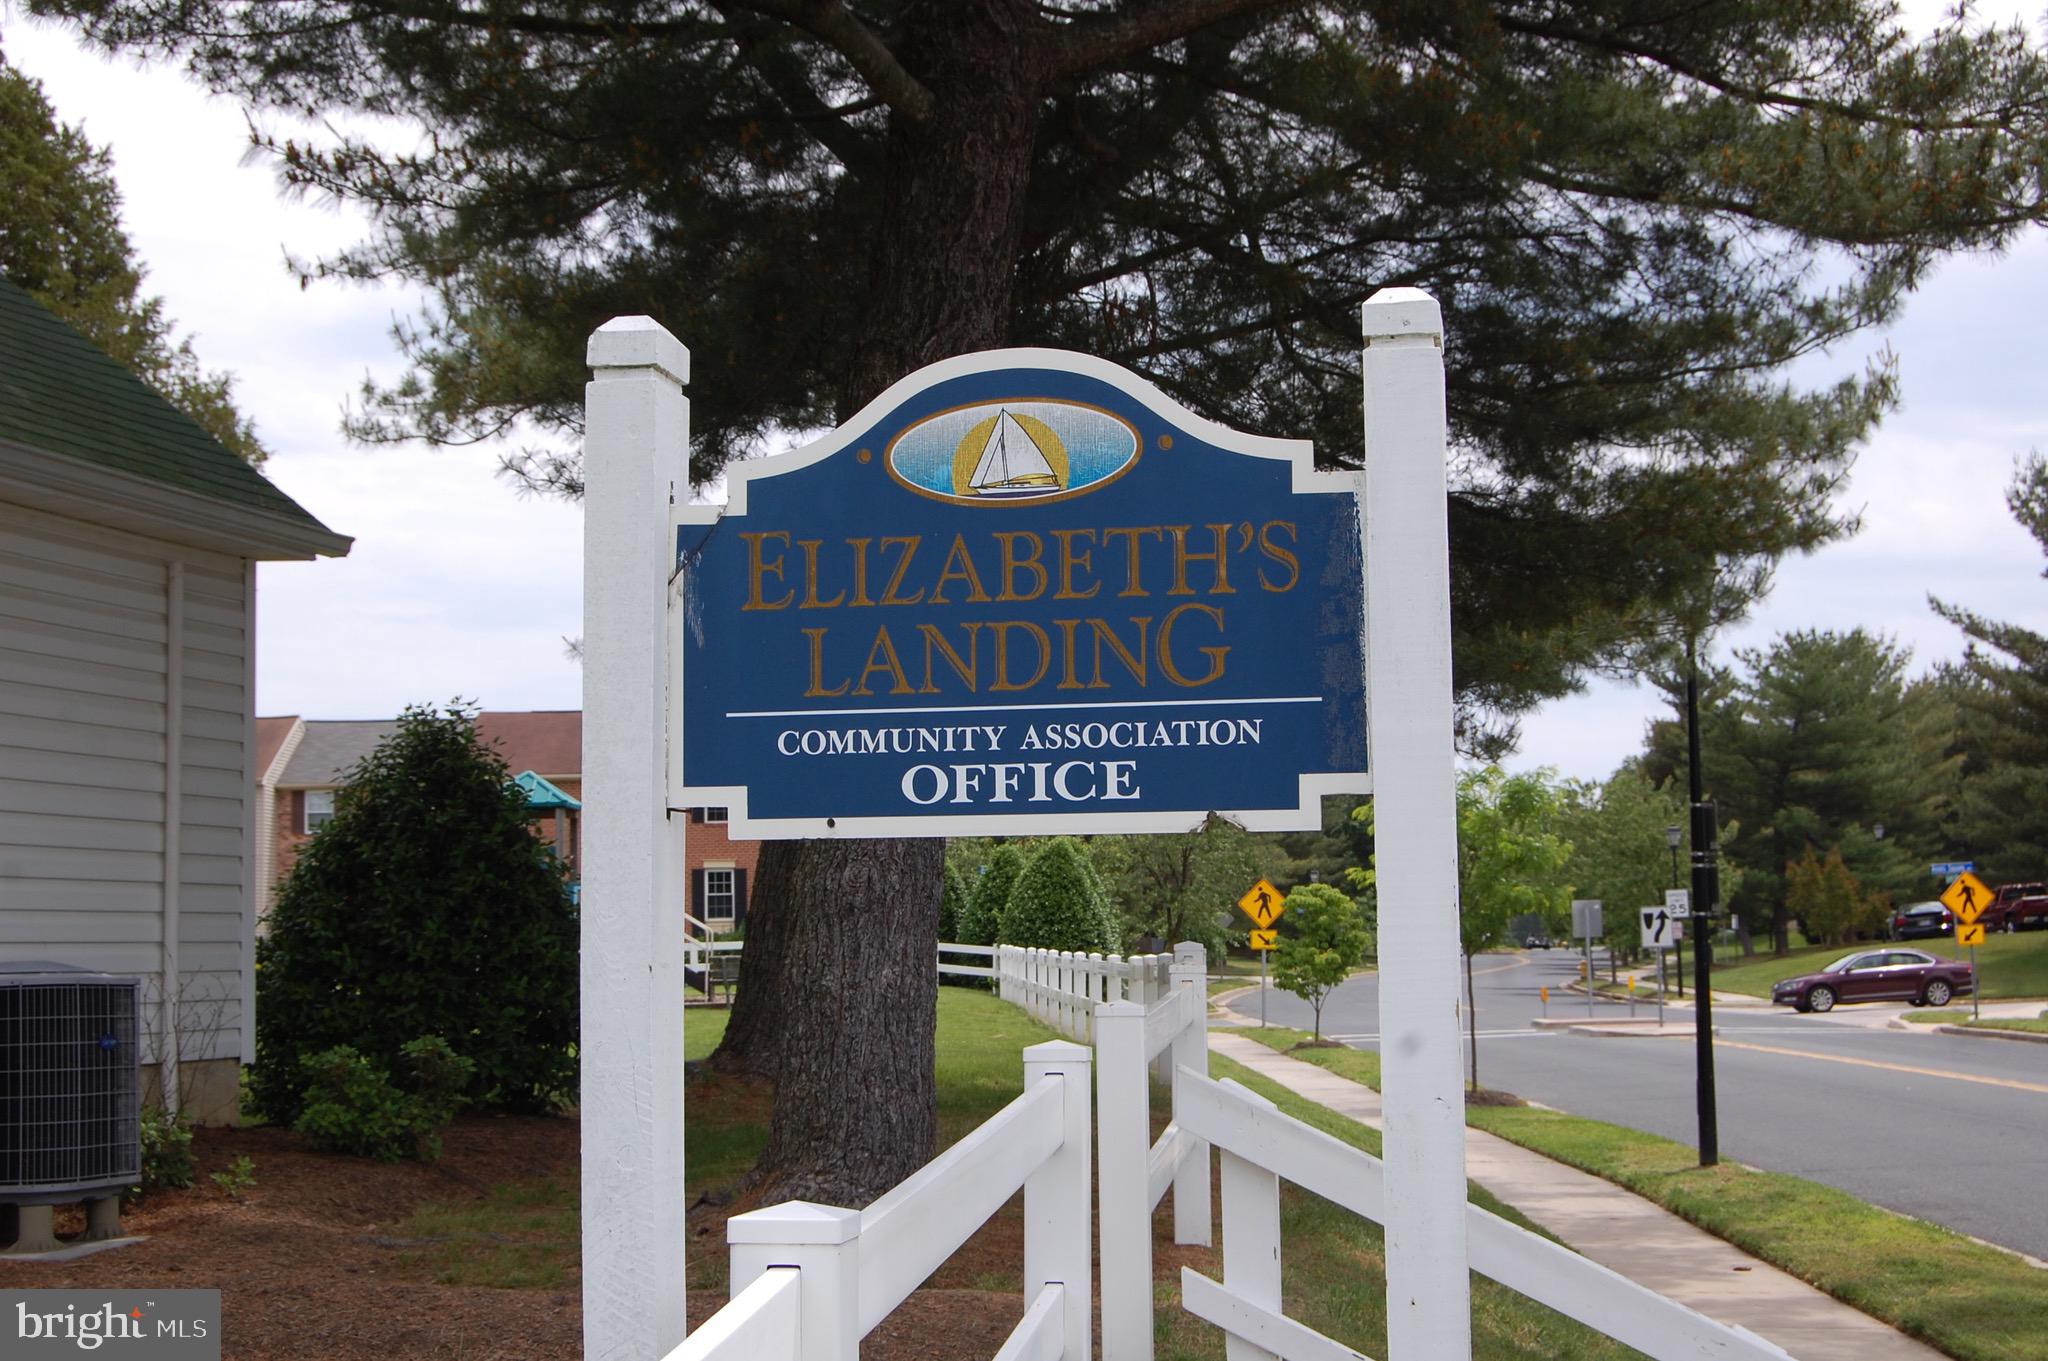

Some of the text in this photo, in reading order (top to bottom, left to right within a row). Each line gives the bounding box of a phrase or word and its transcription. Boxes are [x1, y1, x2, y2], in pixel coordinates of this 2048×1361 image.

[802, 603, 1232, 698] LANDING
[777, 718, 1263, 757] COMMUNITY ASSOCIATION
[900, 761, 1141, 805] OFFICE
[1670, 903, 1687, 914] 25
